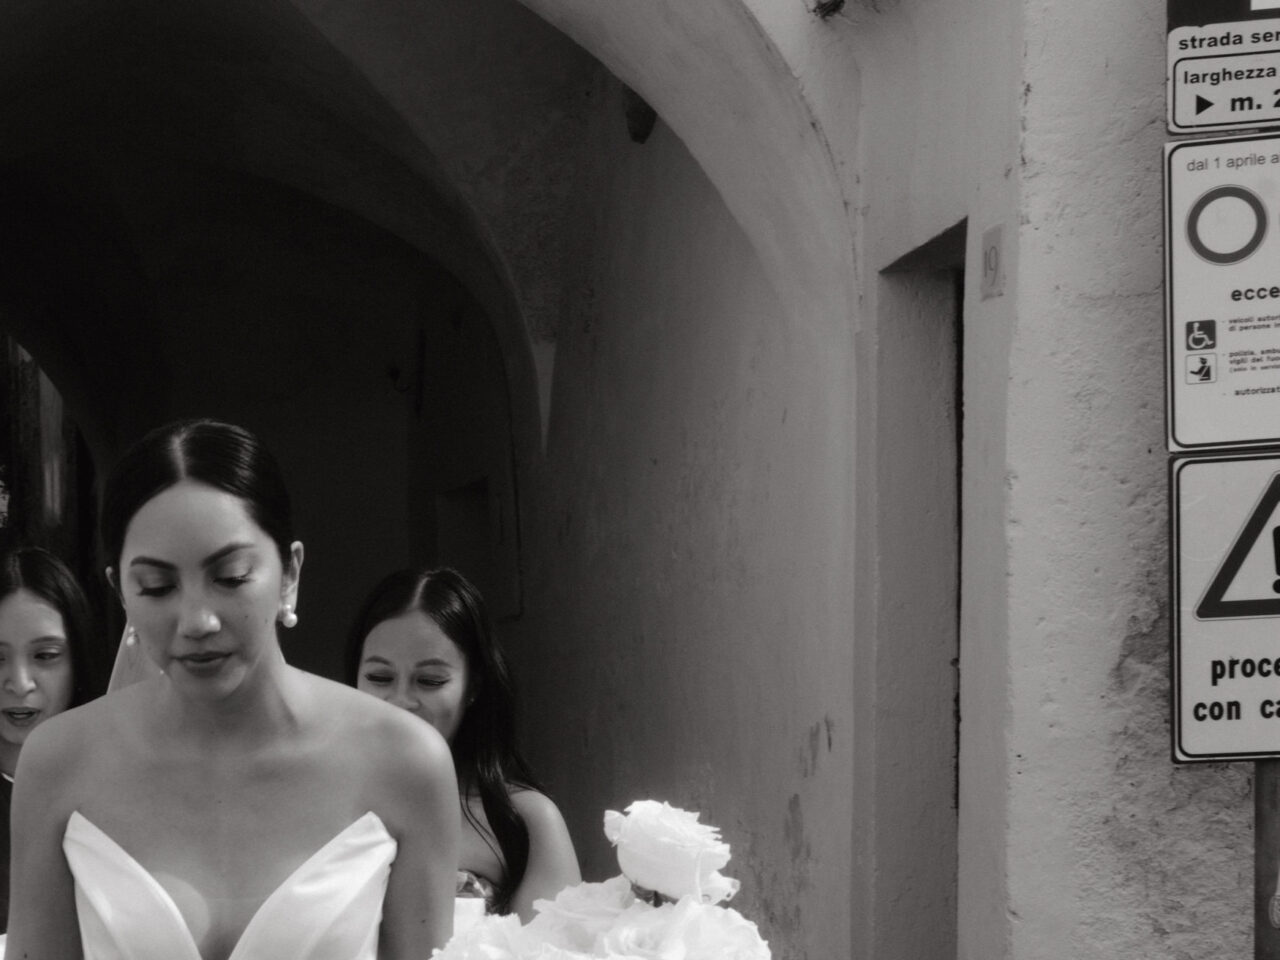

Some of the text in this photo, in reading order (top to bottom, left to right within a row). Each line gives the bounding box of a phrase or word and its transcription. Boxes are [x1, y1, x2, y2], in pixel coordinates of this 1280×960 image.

[1179, 32, 1243, 50] strada
[1184, 67, 1277, 86] larghezza
[1230, 96, 1263, 111] m.
[1187, 157, 1208, 172] dal
[1213, 157, 1221, 169] 1
[1226, 153, 1266, 171] aprile
[1231, 286, 1280, 302] ecce
[1193, 699, 1241, 721] con
